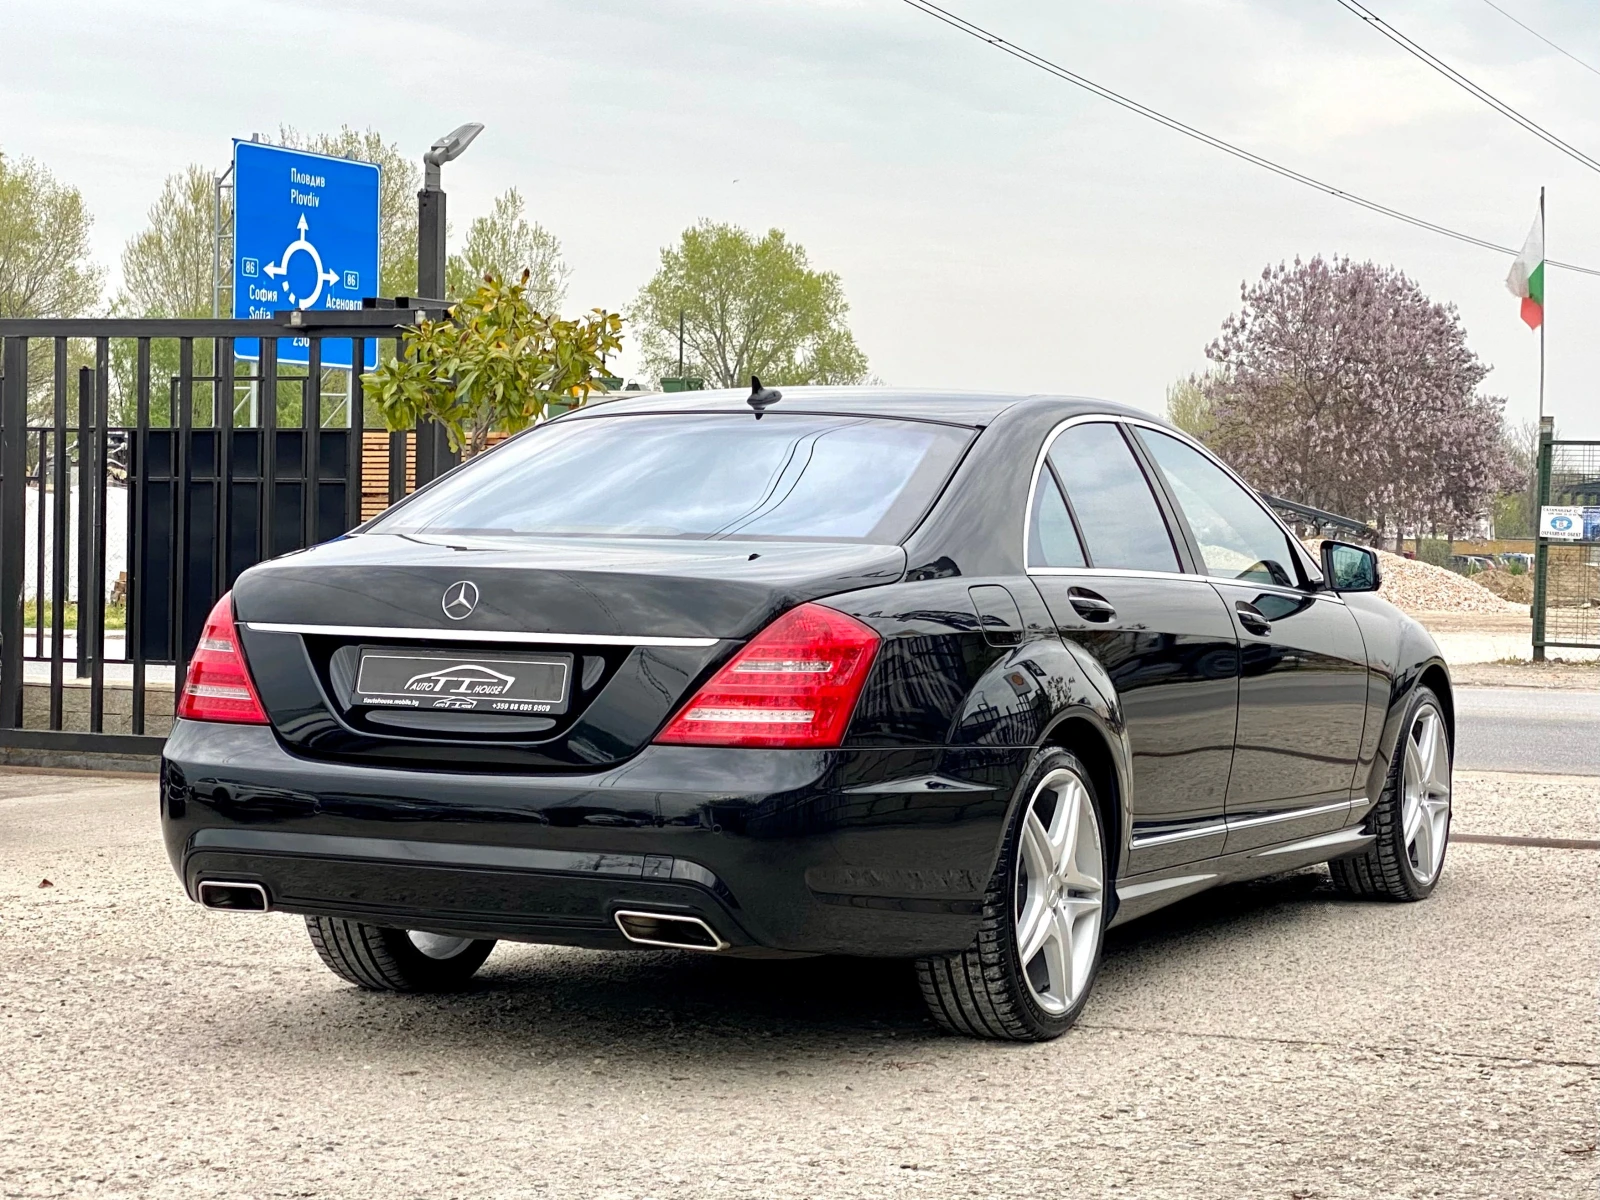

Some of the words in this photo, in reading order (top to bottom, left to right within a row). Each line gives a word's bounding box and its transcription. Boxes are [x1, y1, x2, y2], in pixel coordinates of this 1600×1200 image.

[290, 168, 326, 188] Пловдив
[290, 189, 320, 208] Plovdiv
[245, 261, 255, 274] 86
[346, 273, 356, 286] 86
[249, 284, 278, 303] София
[249, 306, 271, 320] Sofia
[409, 681, 434, 692] AUTO
[473, 684, 503, 695] HOUSE
[510, 703, 518, 711] 88
[533, 704, 551, 712] 9509
